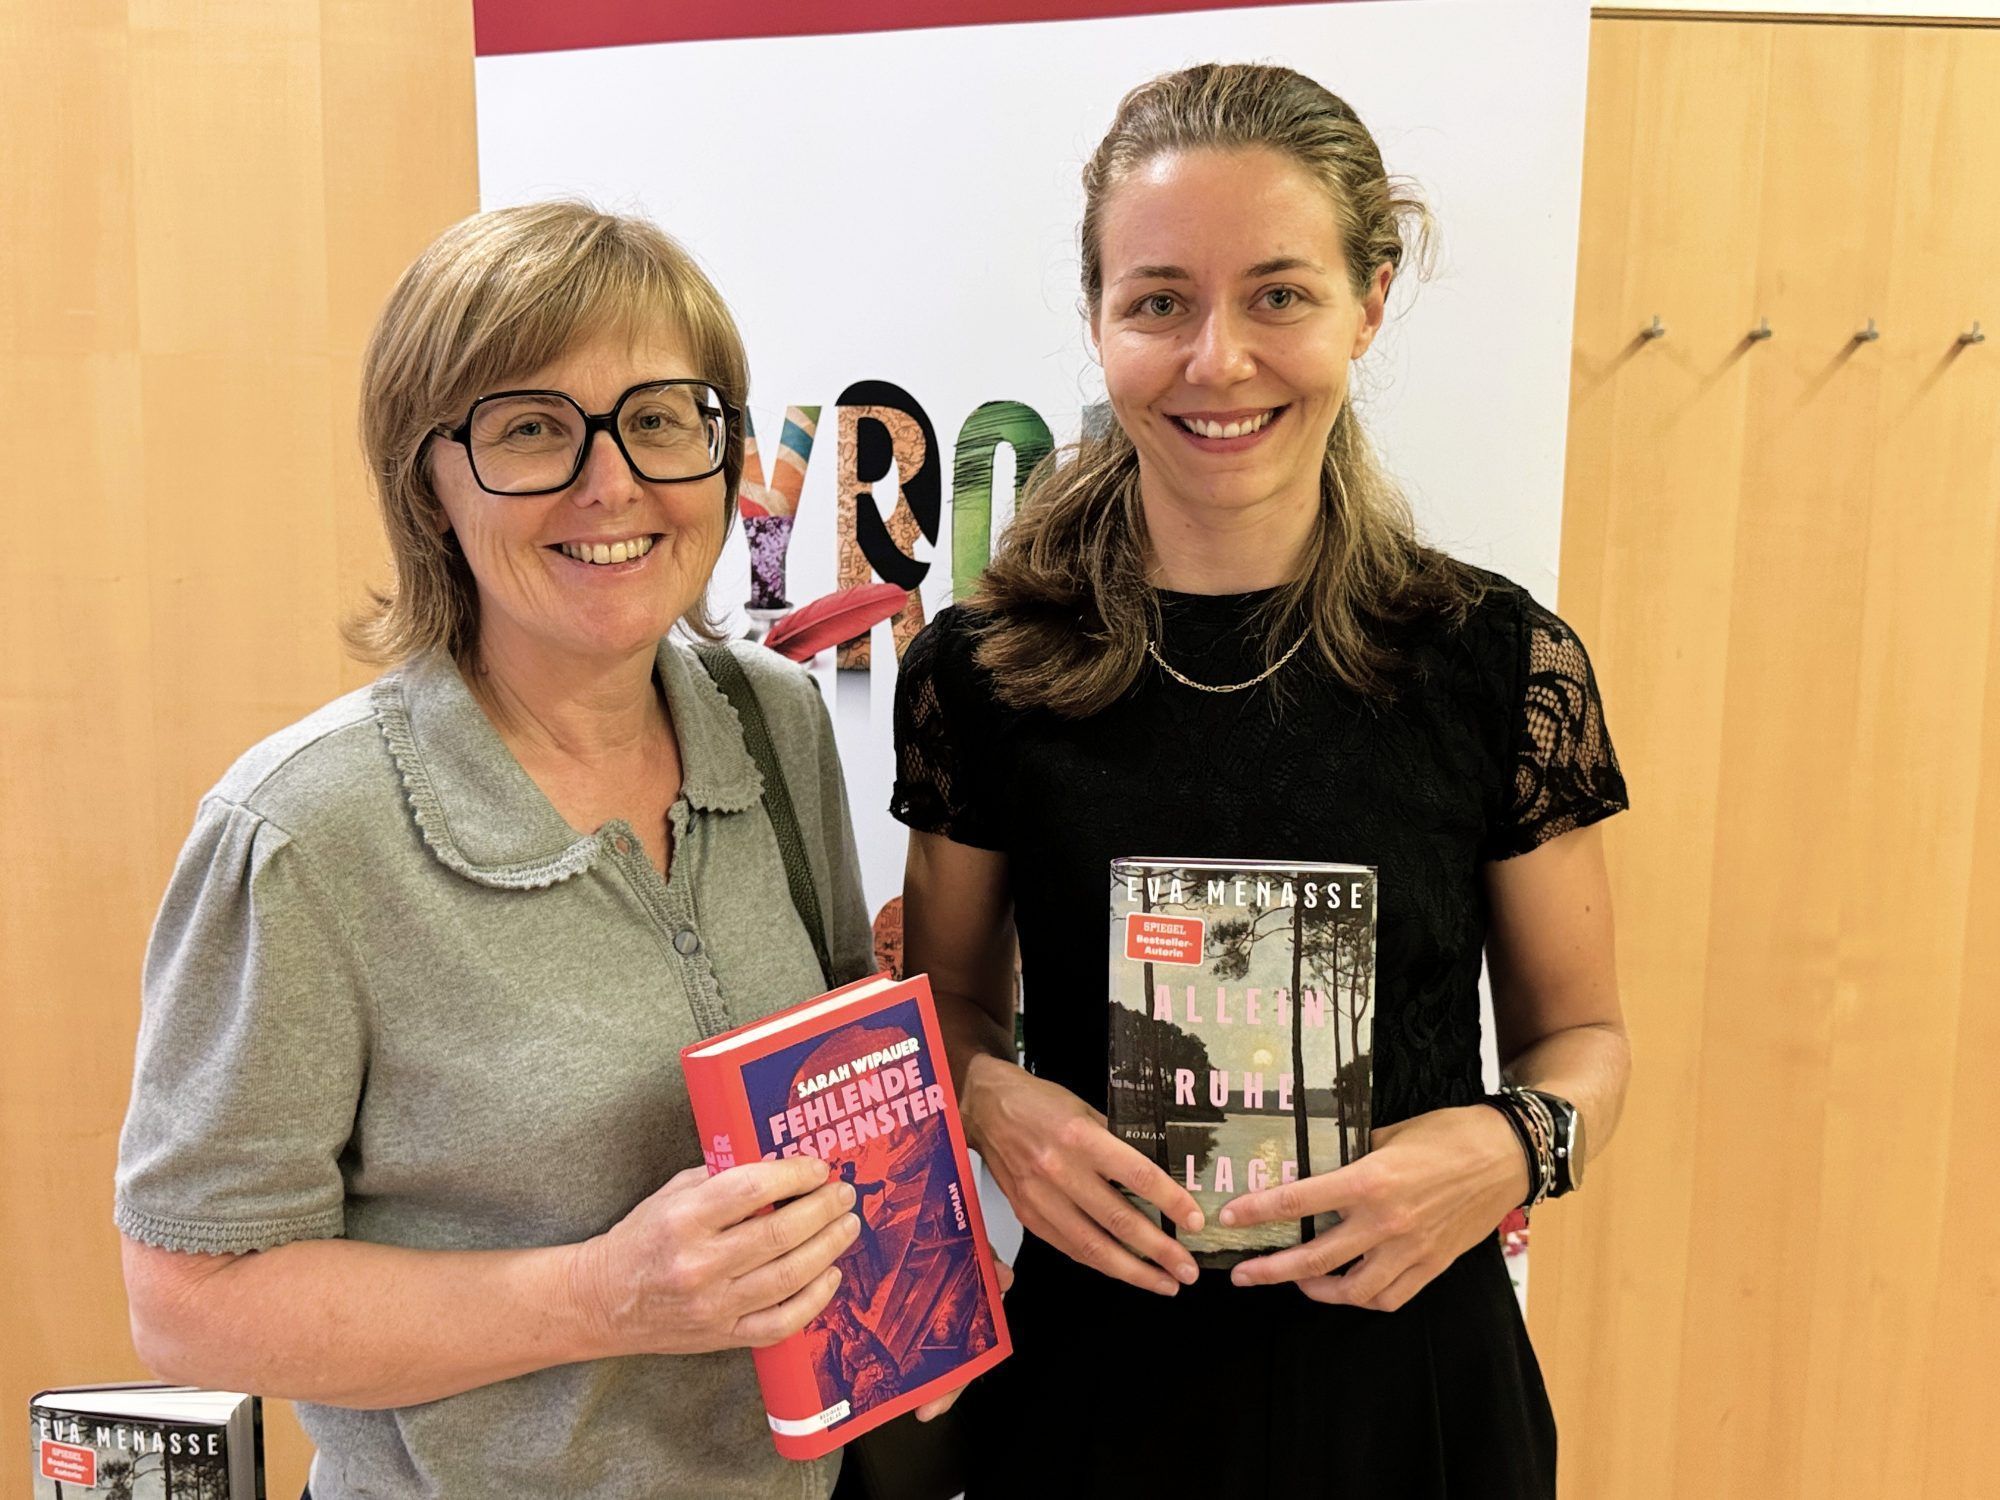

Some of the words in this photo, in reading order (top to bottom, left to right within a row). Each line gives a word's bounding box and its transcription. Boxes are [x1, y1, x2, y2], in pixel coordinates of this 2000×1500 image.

[1127, 876, 1183, 904] EVA
[1207, 879, 1363, 909] MENASSE
[1136, 934, 1194, 947] Bestseller-
[1143, 921, 1187, 935] SPIEGEL
[1144, 945, 1184, 959] Autorin
[1153, 984, 1325, 1028] ALLEIN
[797, 1063, 851, 1099] SARAH
[851, 1037, 920, 1075] WIPAUER
[769, 1058, 923, 1146] FEHLENDE
[1175, 1068, 1295, 1111] RUHE
[1125, 1130, 1167, 1141] ROMAN
[949, 1182, 967, 1231] ROMAN
[39, 1418, 81, 1444] EVA
[96, 1426, 219, 1456] MENASSE
